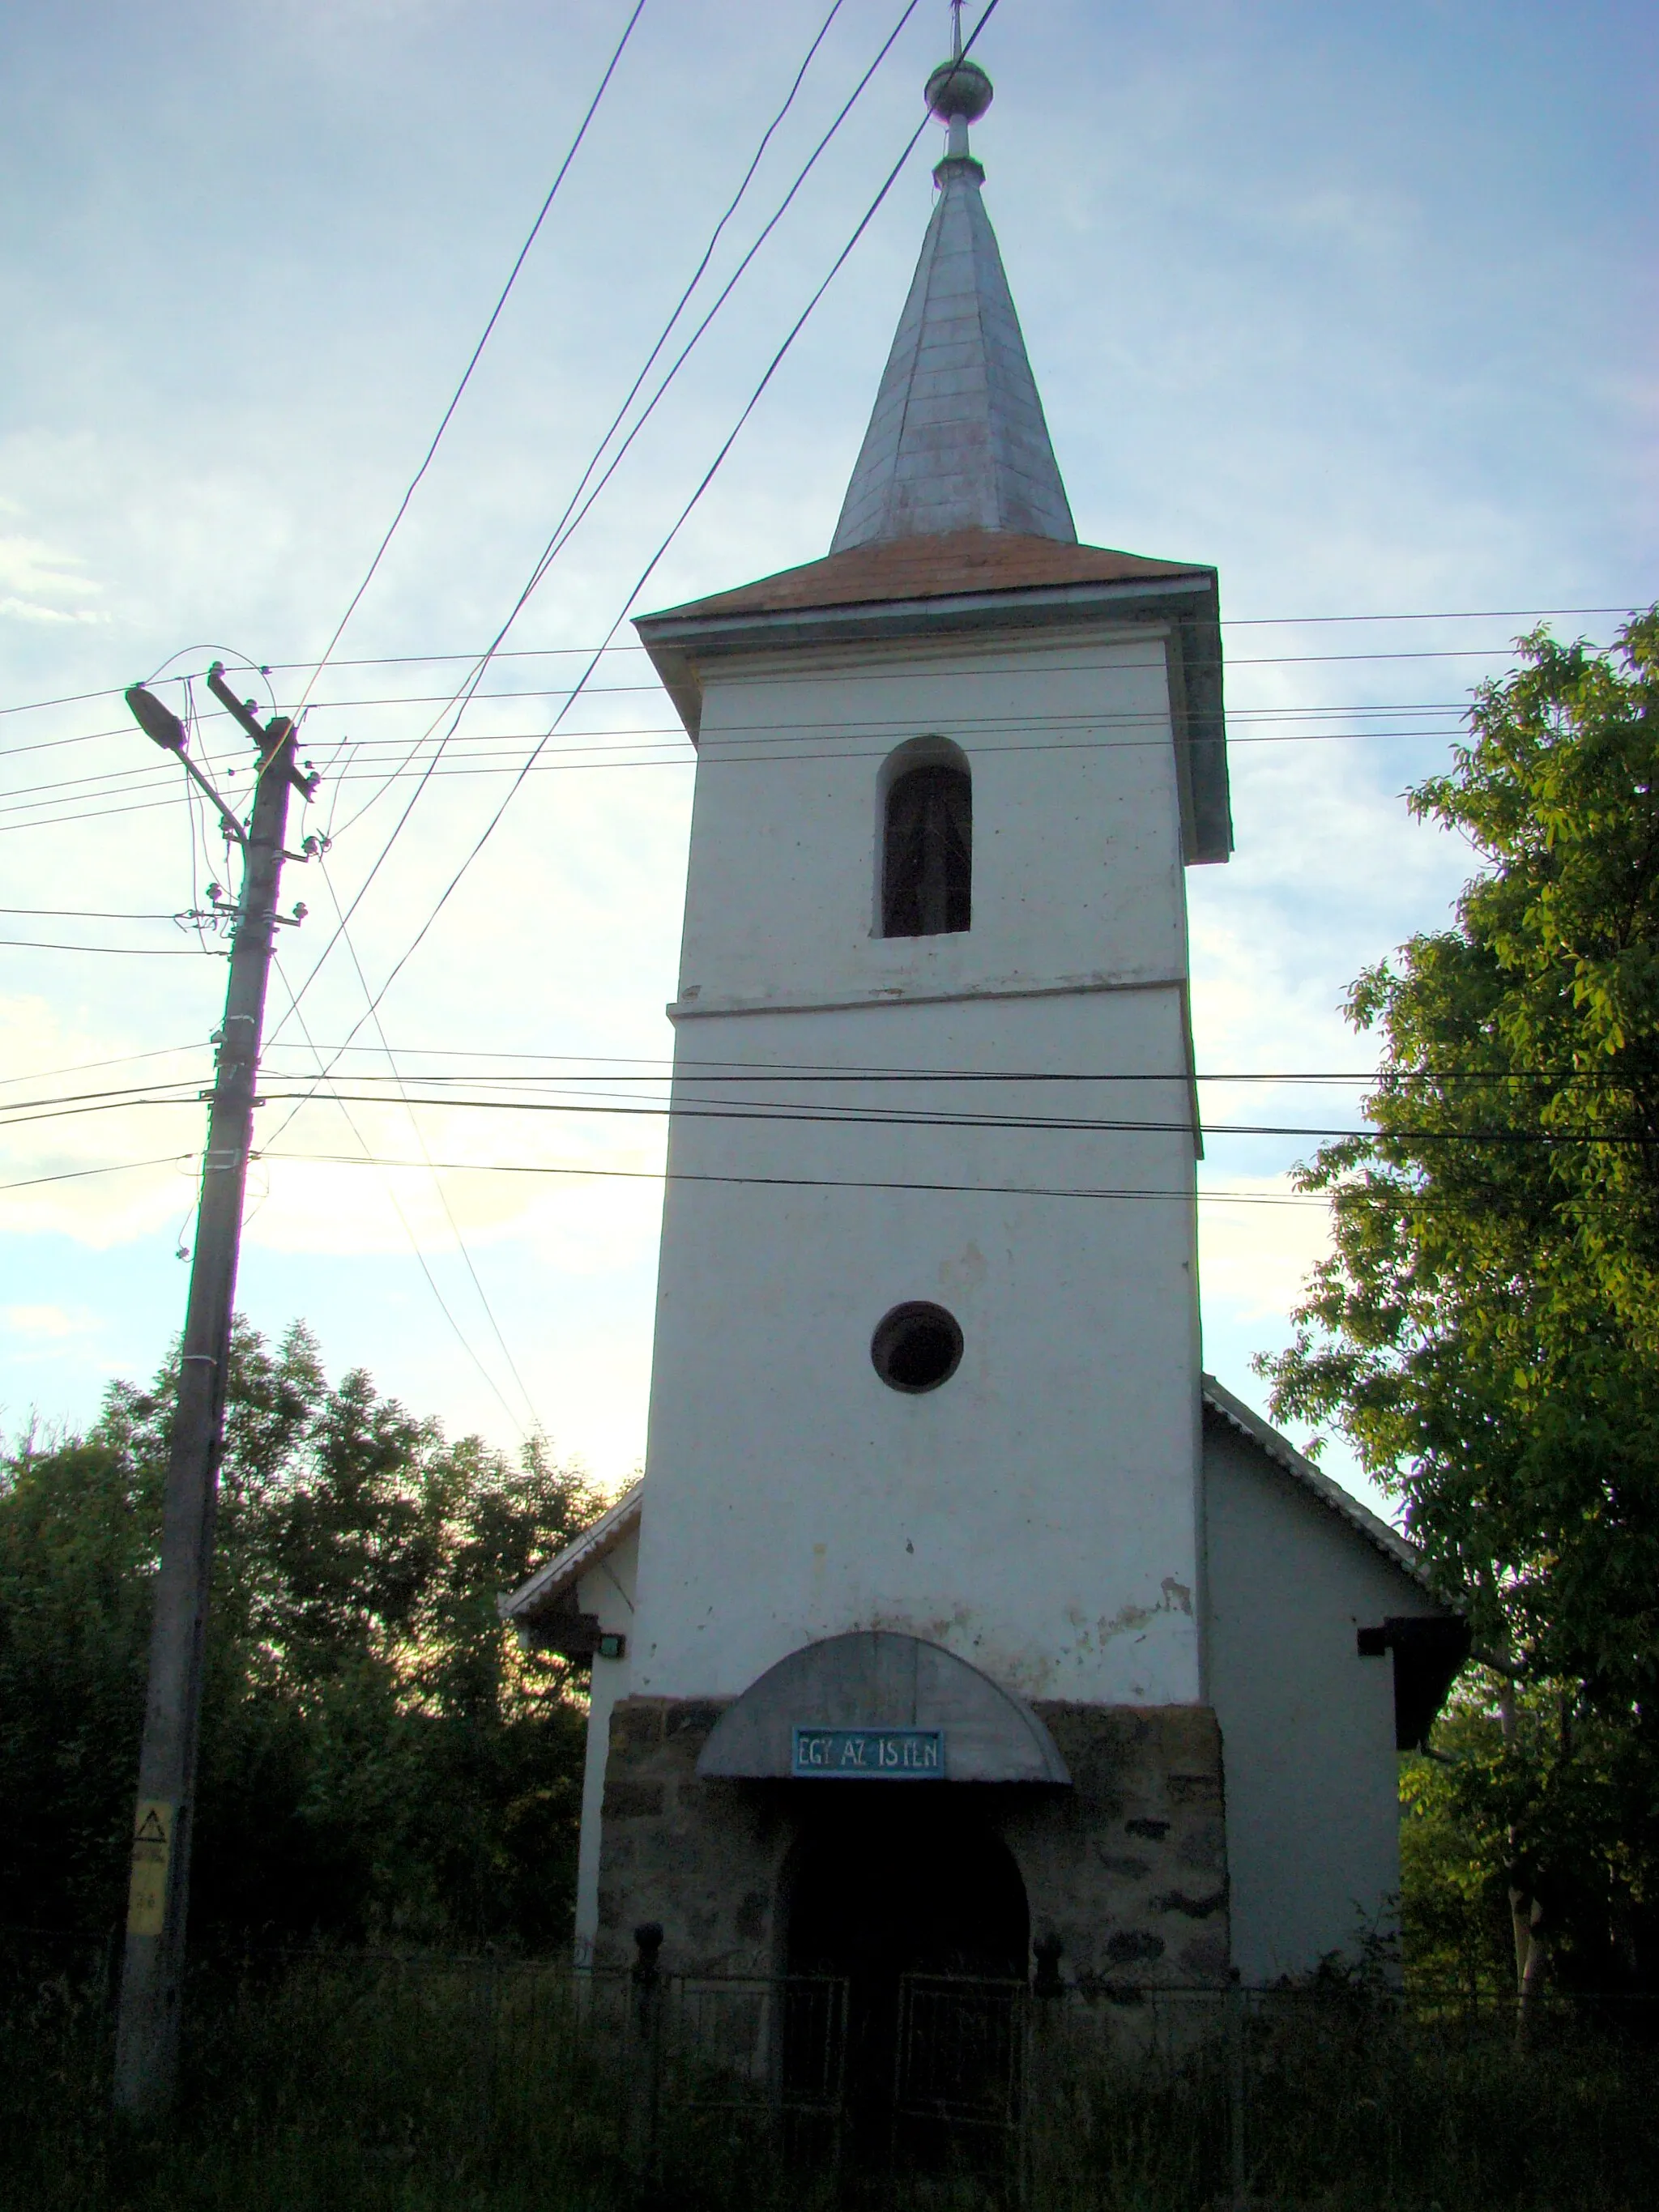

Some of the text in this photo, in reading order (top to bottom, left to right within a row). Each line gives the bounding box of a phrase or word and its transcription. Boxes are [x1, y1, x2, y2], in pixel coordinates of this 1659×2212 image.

[799, 1737, 937, 1767] EGY AZ ISTEN
